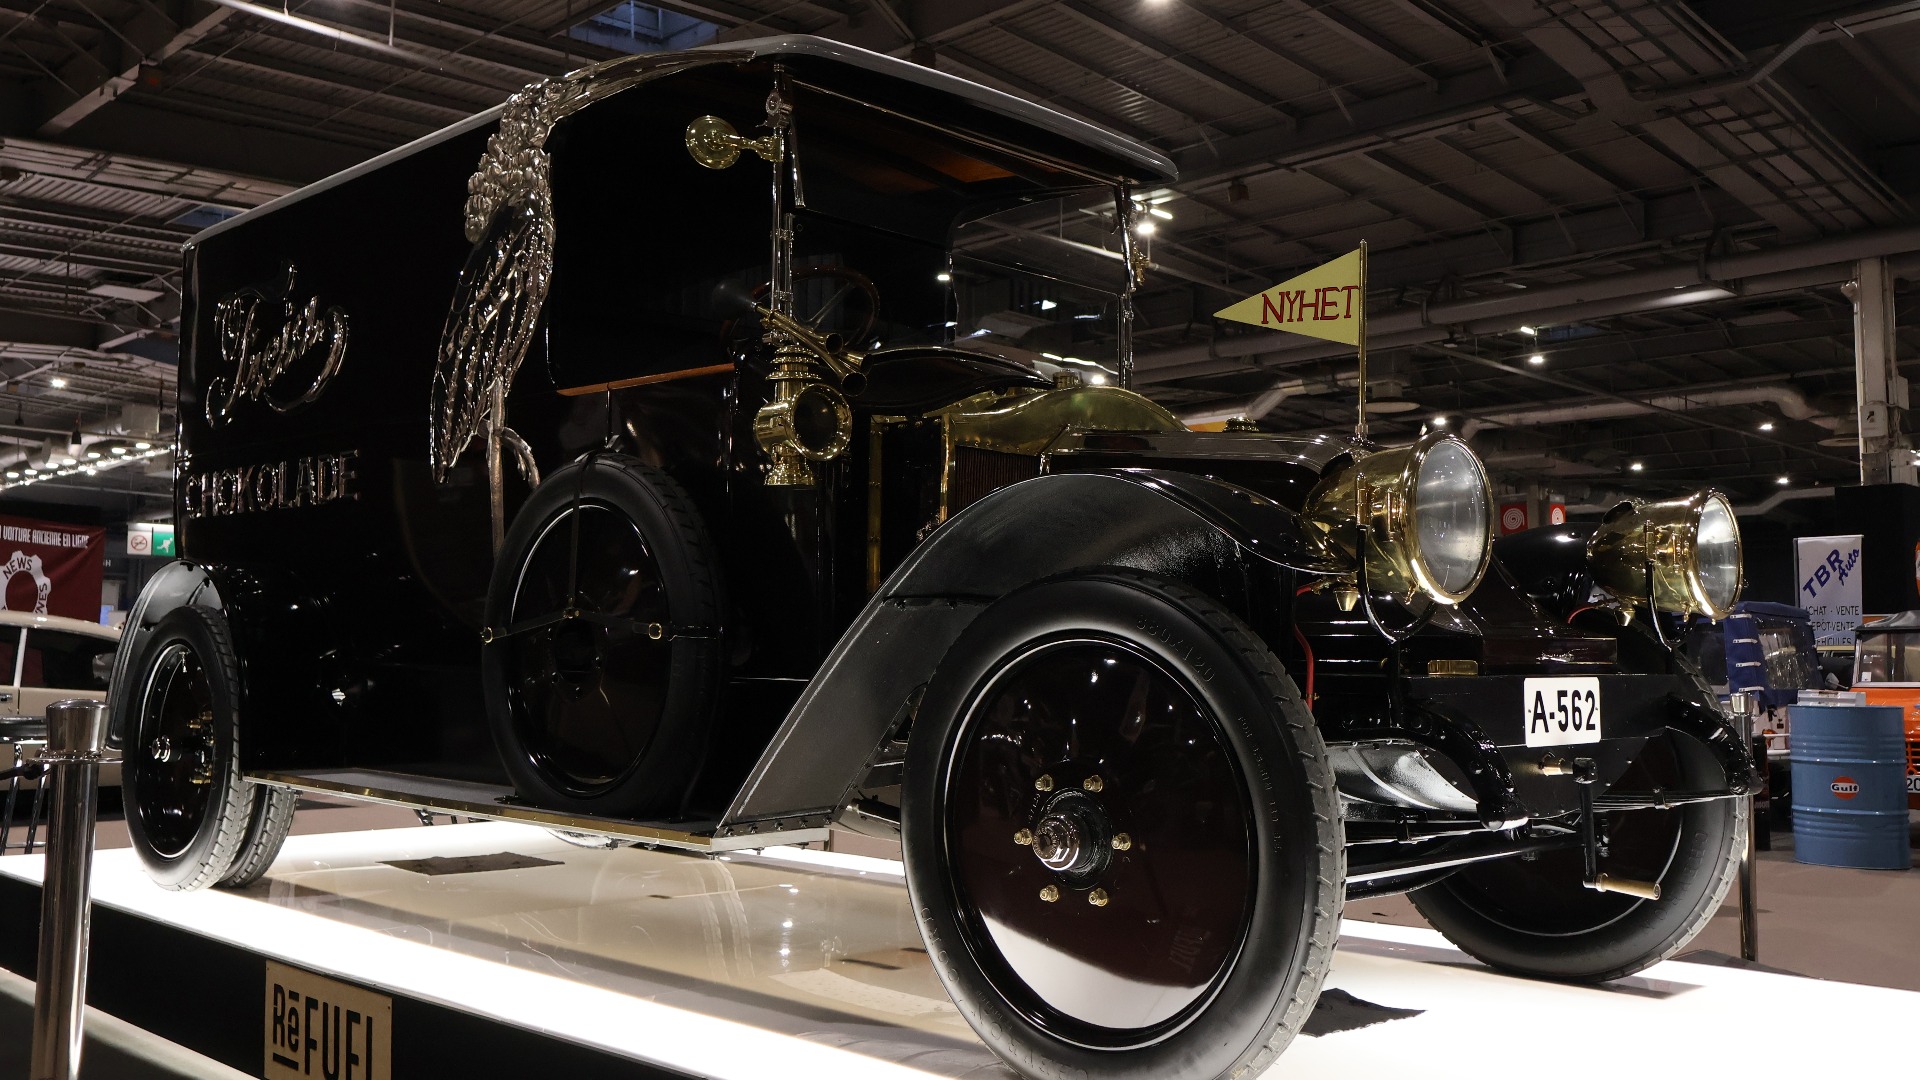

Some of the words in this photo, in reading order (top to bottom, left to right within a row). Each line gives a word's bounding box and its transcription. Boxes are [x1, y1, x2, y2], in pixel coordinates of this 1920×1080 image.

[1261, 285, 1360, 325] NYHET
[184, 449, 361, 519] CHOKOLADE
[3, 525, 31, 543] VOITURE
[32, 529, 62, 547] ANCIENNE
[62, 533, 71, 547] EN
[3, 557, 33, 579] NEWS
[1802, 549, 1844, 598] TBR
[1838, 548, 1860, 586] Auto
[1835, 605, 1860, 616] VENTE
[1530, 690, 1597, 735] A-562
[1831, 783, 1859, 792] Gulf
